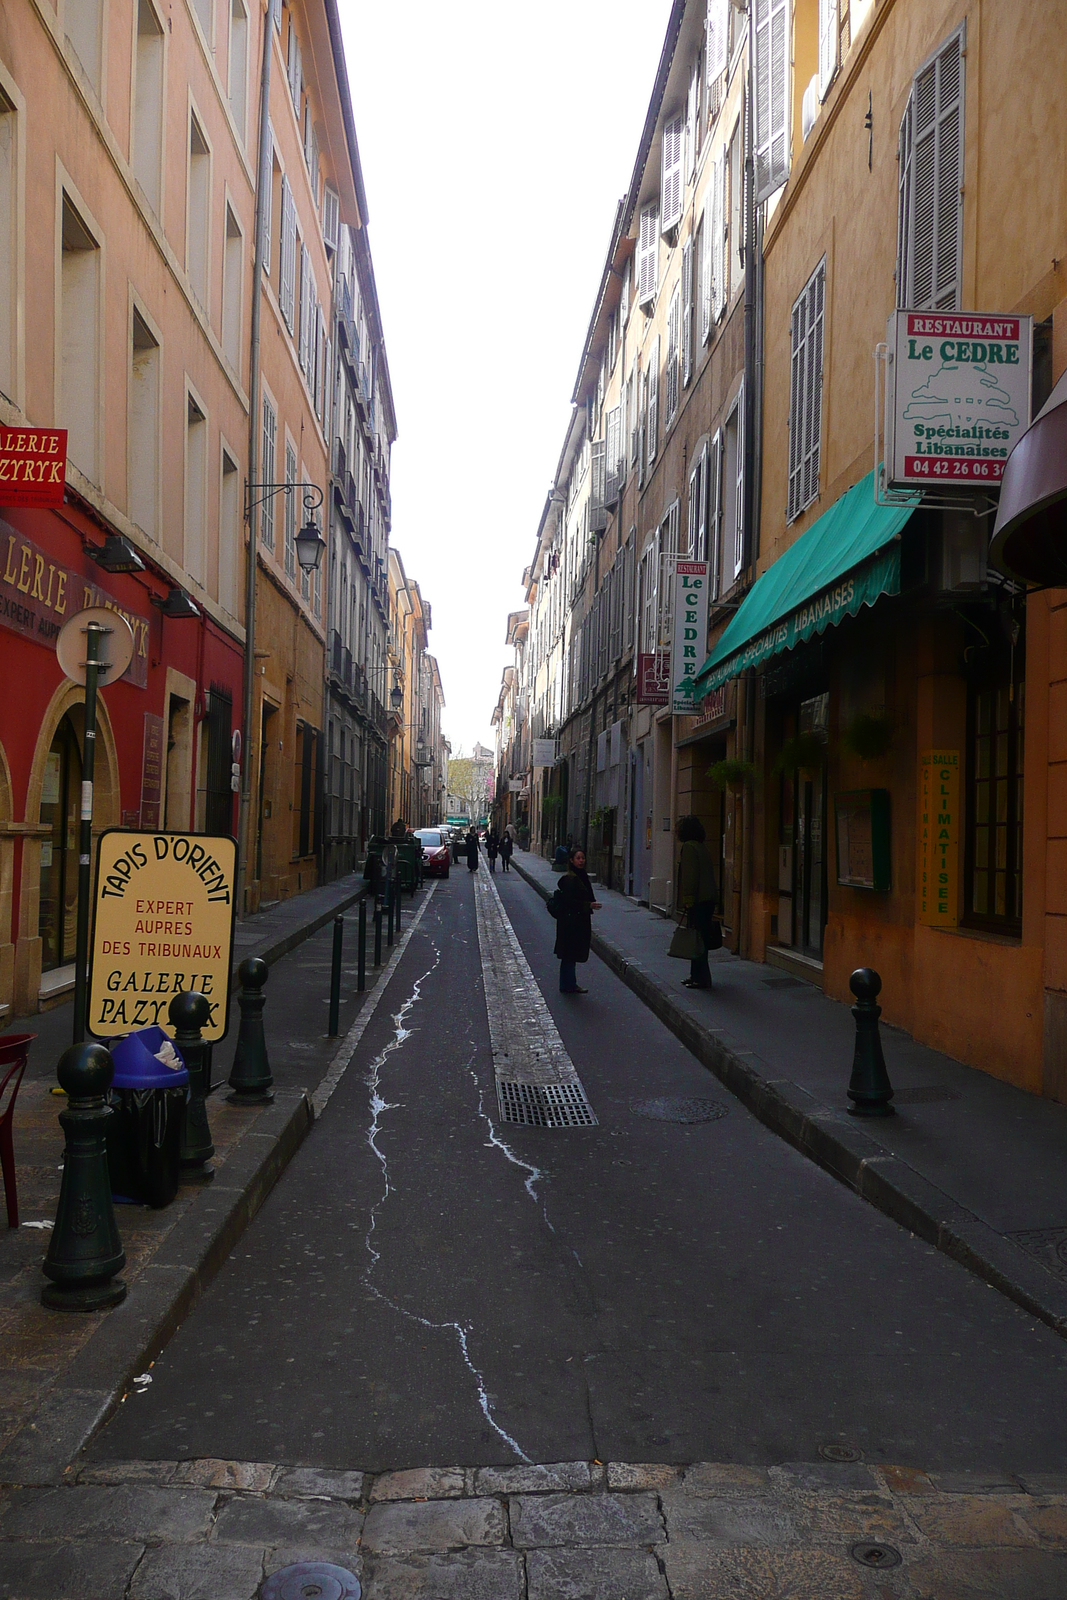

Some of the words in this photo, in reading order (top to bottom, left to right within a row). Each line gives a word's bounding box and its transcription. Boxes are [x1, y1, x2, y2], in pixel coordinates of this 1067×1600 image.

[913, 318, 1014, 337] RESTAURANT
[908, 339, 934, 361] Le
[939, 340, 1020, 365] CEDRE
[913, 423, 1010, 441] Spécialités
[0, 433, 59, 454] LERIE
[915, 441, 1008, 458] Libanaises
[913, 460, 930, 473] 04
[933, 461, 949, 474] 42
[953, 462, 969, 475] 26
[972, 463, 989, 476] 06
[0, 535, 67, 615] LERIE
[677, 564, 706, 574] RESTAURANT
[681, 575, 703, 589] Le
[742, 622, 789, 664] SPECIALITES
[793, 579, 854, 634] LIBANAISES
[683, 592, 698, 675] CEDRE
[933, 754, 958, 765] SALLE
[937, 769, 951, 914] CLIMATISEE
[101, 842, 148, 899] TAPIS
[153, 836, 230, 905] D'ORIENT
[136, 899, 194, 916] EXPERT
[134, 920, 193, 936] AUPRES
[102, 940, 131, 956] DES
[138, 942, 222, 960] TRIBUNAUX
[106, 970, 214, 995] GALERIE
[97, 998, 221, 1029] PAZYK
